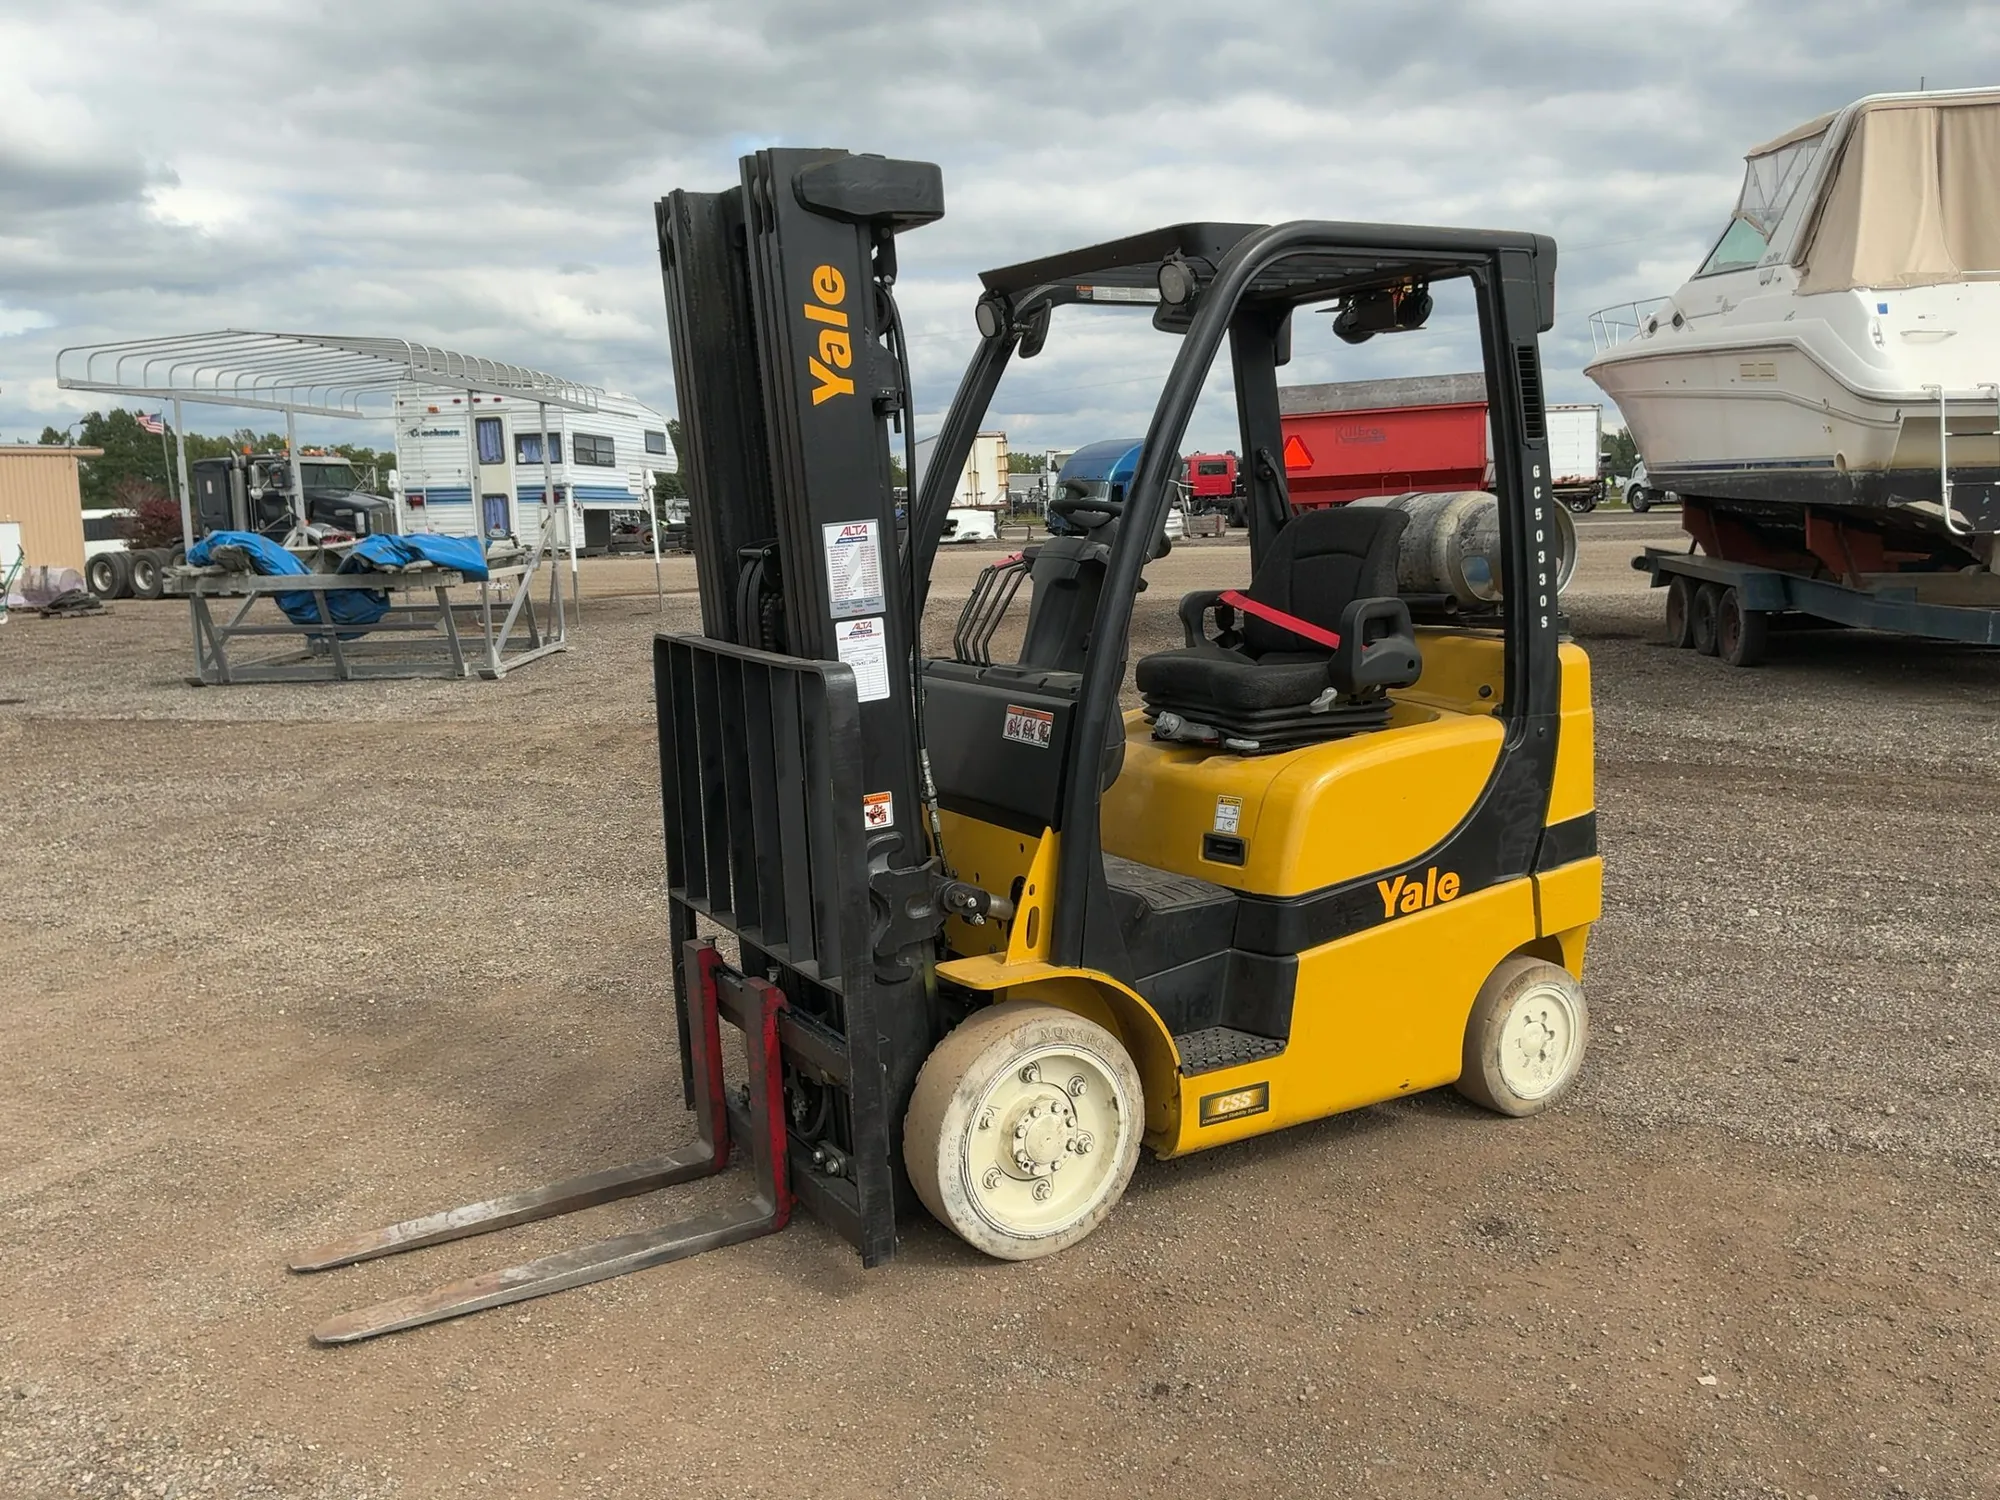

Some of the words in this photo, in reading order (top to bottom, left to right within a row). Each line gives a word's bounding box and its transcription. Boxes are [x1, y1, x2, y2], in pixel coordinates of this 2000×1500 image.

[804, 264, 855, 406] Yale
[840, 525, 868, 537] ALTA
[852, 621, 872, 631] ALTA
[1377, 867, 1460, 918] Yale
[1218, 1091, 1252, 1113] CSS
